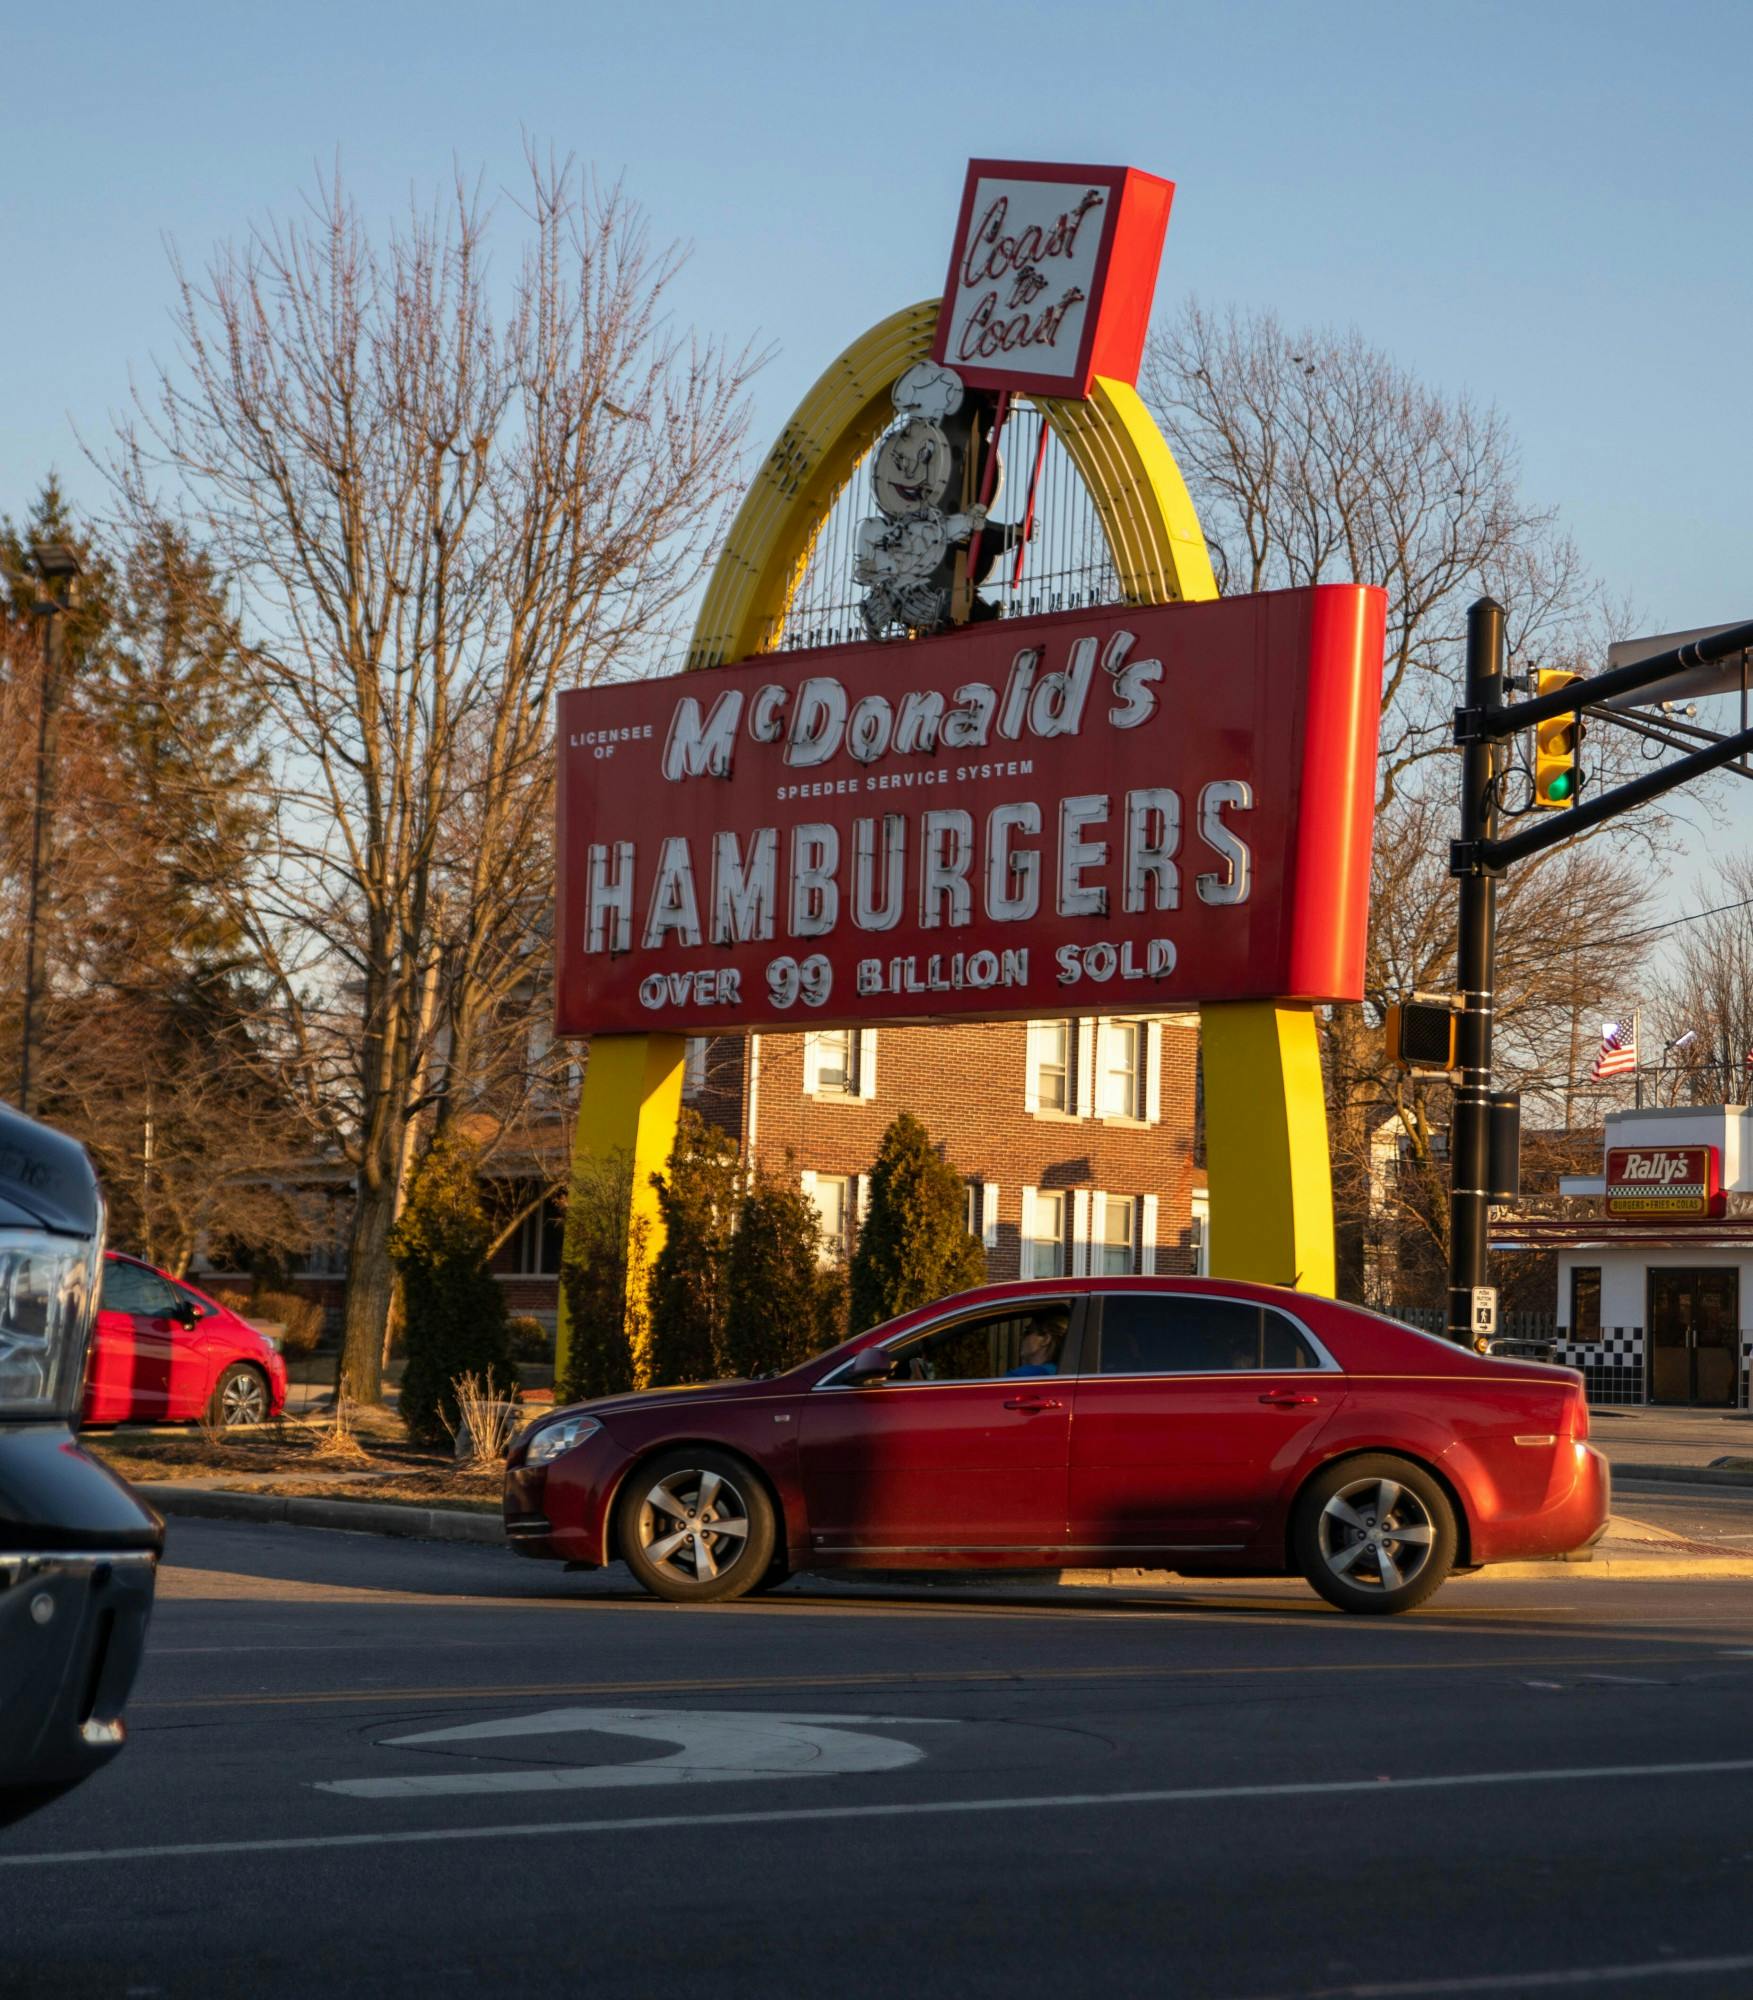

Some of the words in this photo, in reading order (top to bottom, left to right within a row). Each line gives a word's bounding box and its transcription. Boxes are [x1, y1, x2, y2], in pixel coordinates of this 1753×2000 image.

[963, 189, 1103, 288] Coast
[1007, 265, 1048, 309] to
[957, 287, 1085, 361] Coast
[661, 630, 1163, 782] McDonald's
[570, 725, 652, 746] LICENSEE
[594, 745, 614, 759] OF
[777, 779, 858, 799] SPEEDEE
[867, 770, 948, 790] SERVICE
[957, 760, 1033, 781] SYSTEM
[584, 780, 1253, 954] HAMBURGERS
[639, 968, 742, 1010] OVER
[766, 953, 833, 1009] 99
[857, 948, 1029, 995] BILLION
[1055, 939, 1177, 984] SOLD
[1622, 1152, 1688, 1183] Rally's
[1613, 1199, 1644, 1209] BURGERS
[1676, 1199, 1698, 1209] COLAS
